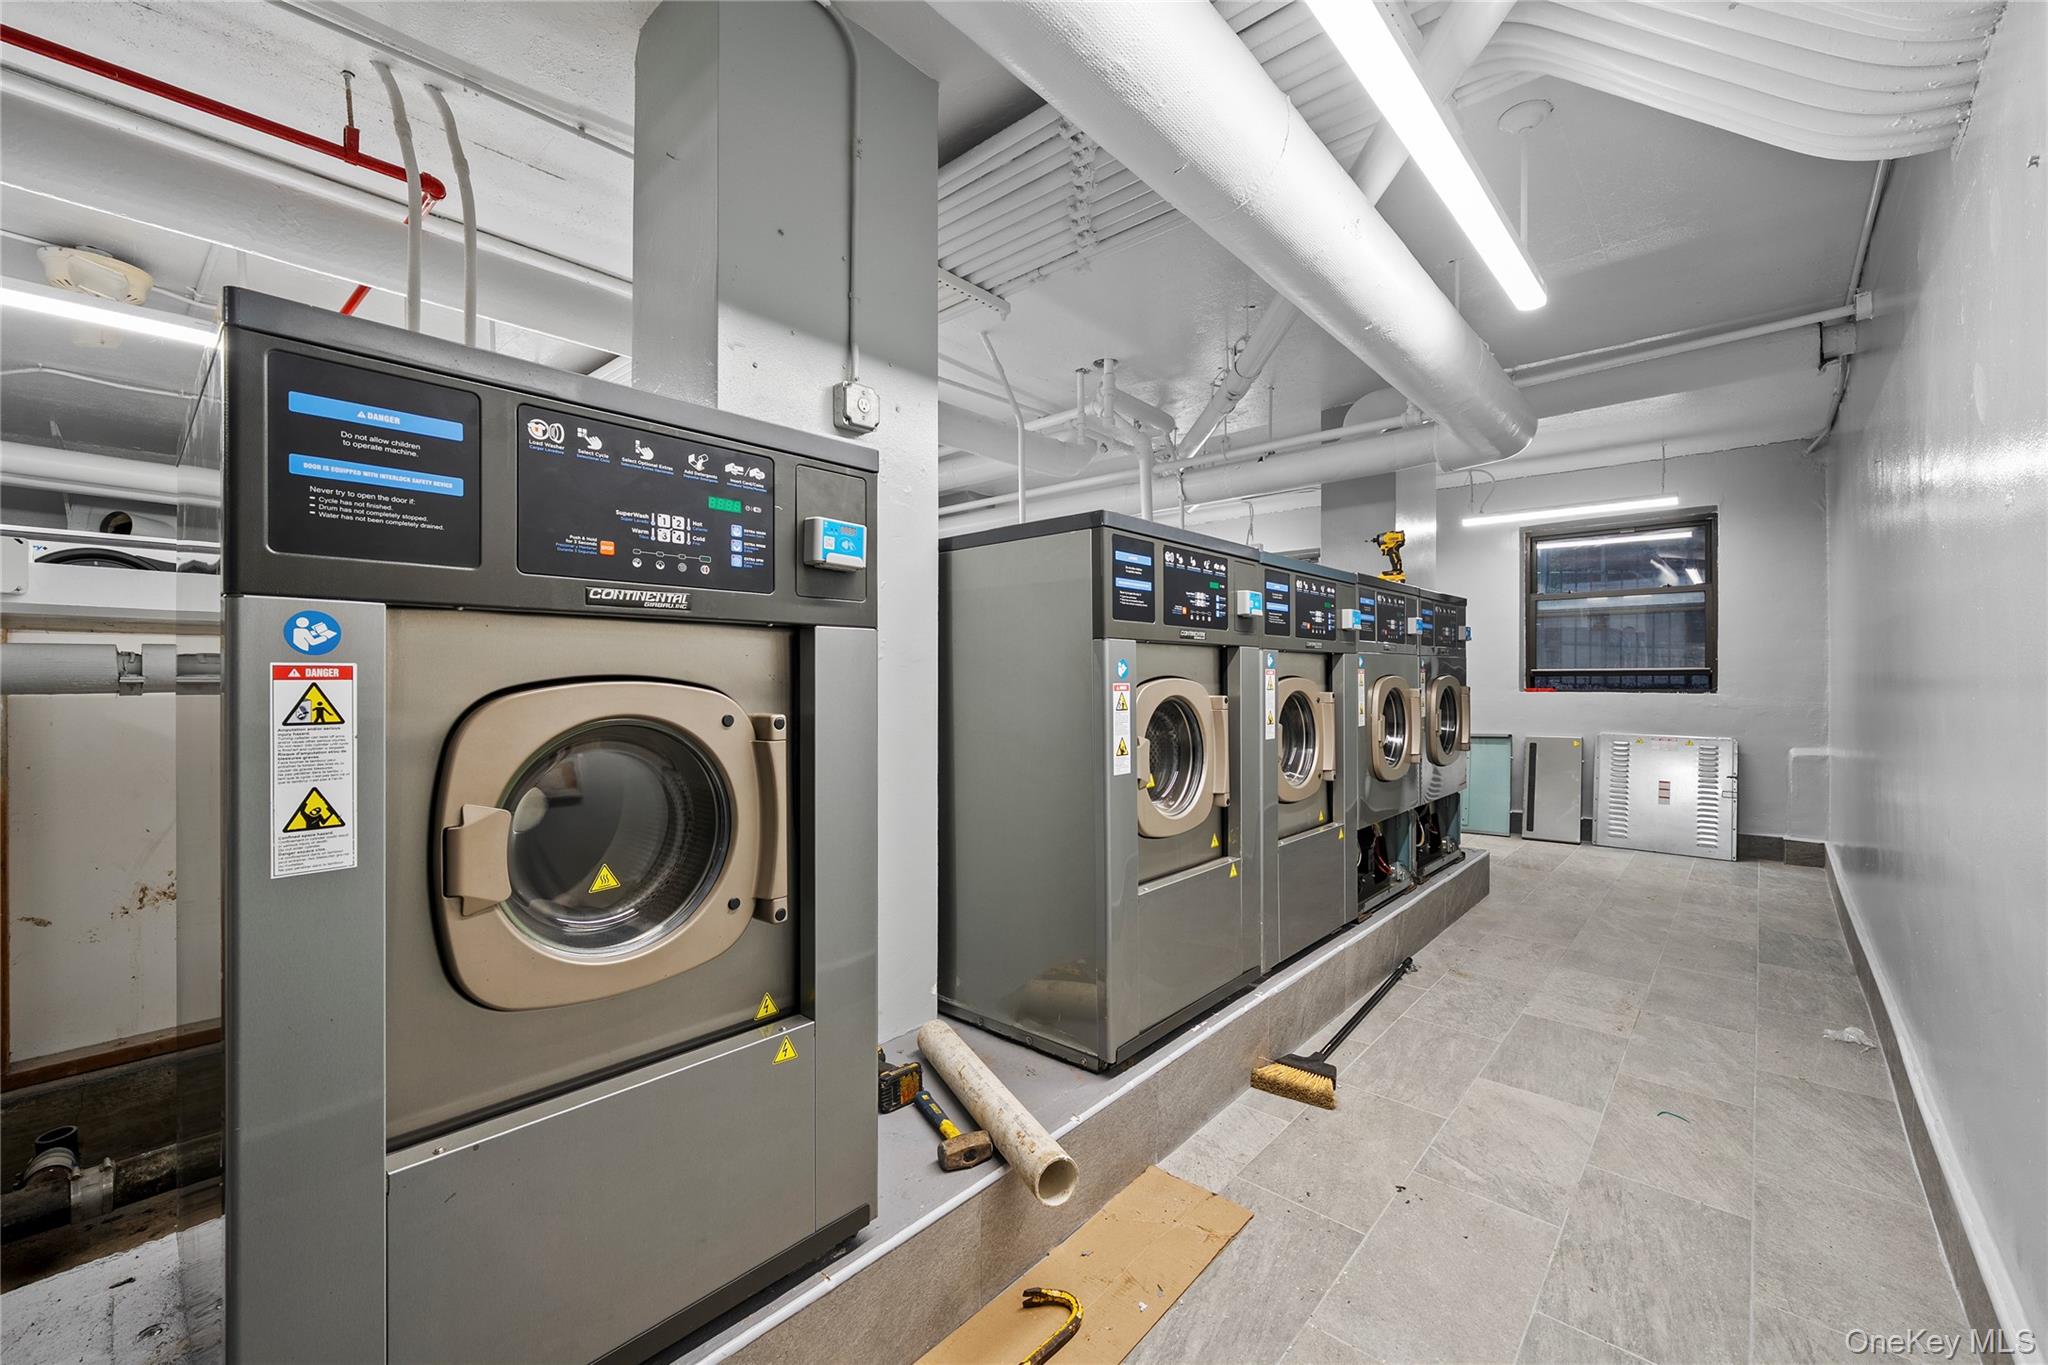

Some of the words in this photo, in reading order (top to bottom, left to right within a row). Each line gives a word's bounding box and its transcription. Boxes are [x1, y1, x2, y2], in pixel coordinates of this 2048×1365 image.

[367, 412, 401, 425] DANGER
[341, 431, 353, 439] Do
[354, 434, 368, 442] not
[369, 436, 389, 445] allow
[391, 439, 421, 450] children
[528, 439, 543, 447] Load
[544, 442, 565, 450] Washer
[352, 442, 383, 452] operate
[385, 447, 419, 458] machine.
[577, 448, 594, 456] Select
[621, 456, 637, 464] Select
[303, 462, 321, 471] DOOR
[331, 466, 361, 476] EQUIPPED
[363, 470, 379, 479] WITH
[380, 473, 411, 483] INTERLOCK
[412, 478, 432, 486] SAFETY
[309, 485, 334, 495] Never
[335, 489, 346, 498] try
[347, 490, 355, 498] to
[357, 492, 376, 501] open
[377, 493, 390, 502] the
[391, 496, 408, 504] door
[318, 496, 338, 505] Cycle
[339, 499, 352, 507] has
[319, 504, 338, 512] Drum
[339, 506, 352, 514] has
[366, 509, 400, 520] completely
[615, 509, 649, 519] SuperWash
[319, 511, 340, 520] Water
[367, 516, 384, 524] been
[385, 519, 419, 529] completely
[631, 527, 649, 535] Warm
[589, 587, 690, 604] CONTINENTAL
[305, 668, 340, 678] DANGER
